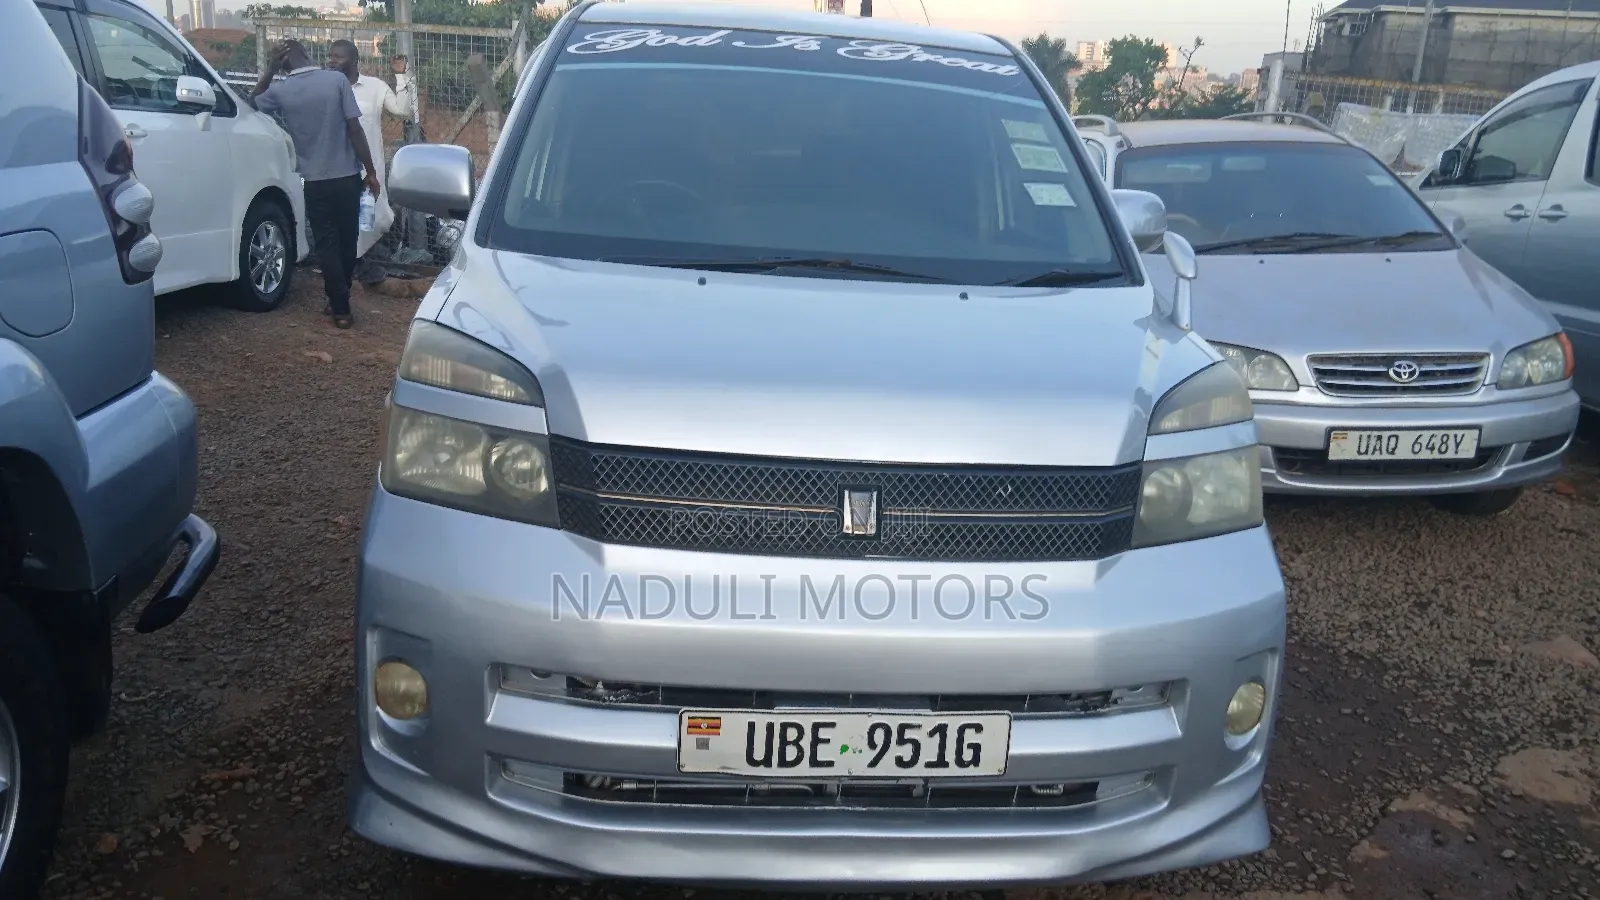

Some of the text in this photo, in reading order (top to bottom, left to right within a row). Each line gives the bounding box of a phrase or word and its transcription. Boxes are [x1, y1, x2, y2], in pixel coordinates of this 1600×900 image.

[566, 28, 1019, 76] God Is Great
[1357, 433, 1465, 456] UAQ 648Y
[745, 721, 984, 769] UBE 951G
